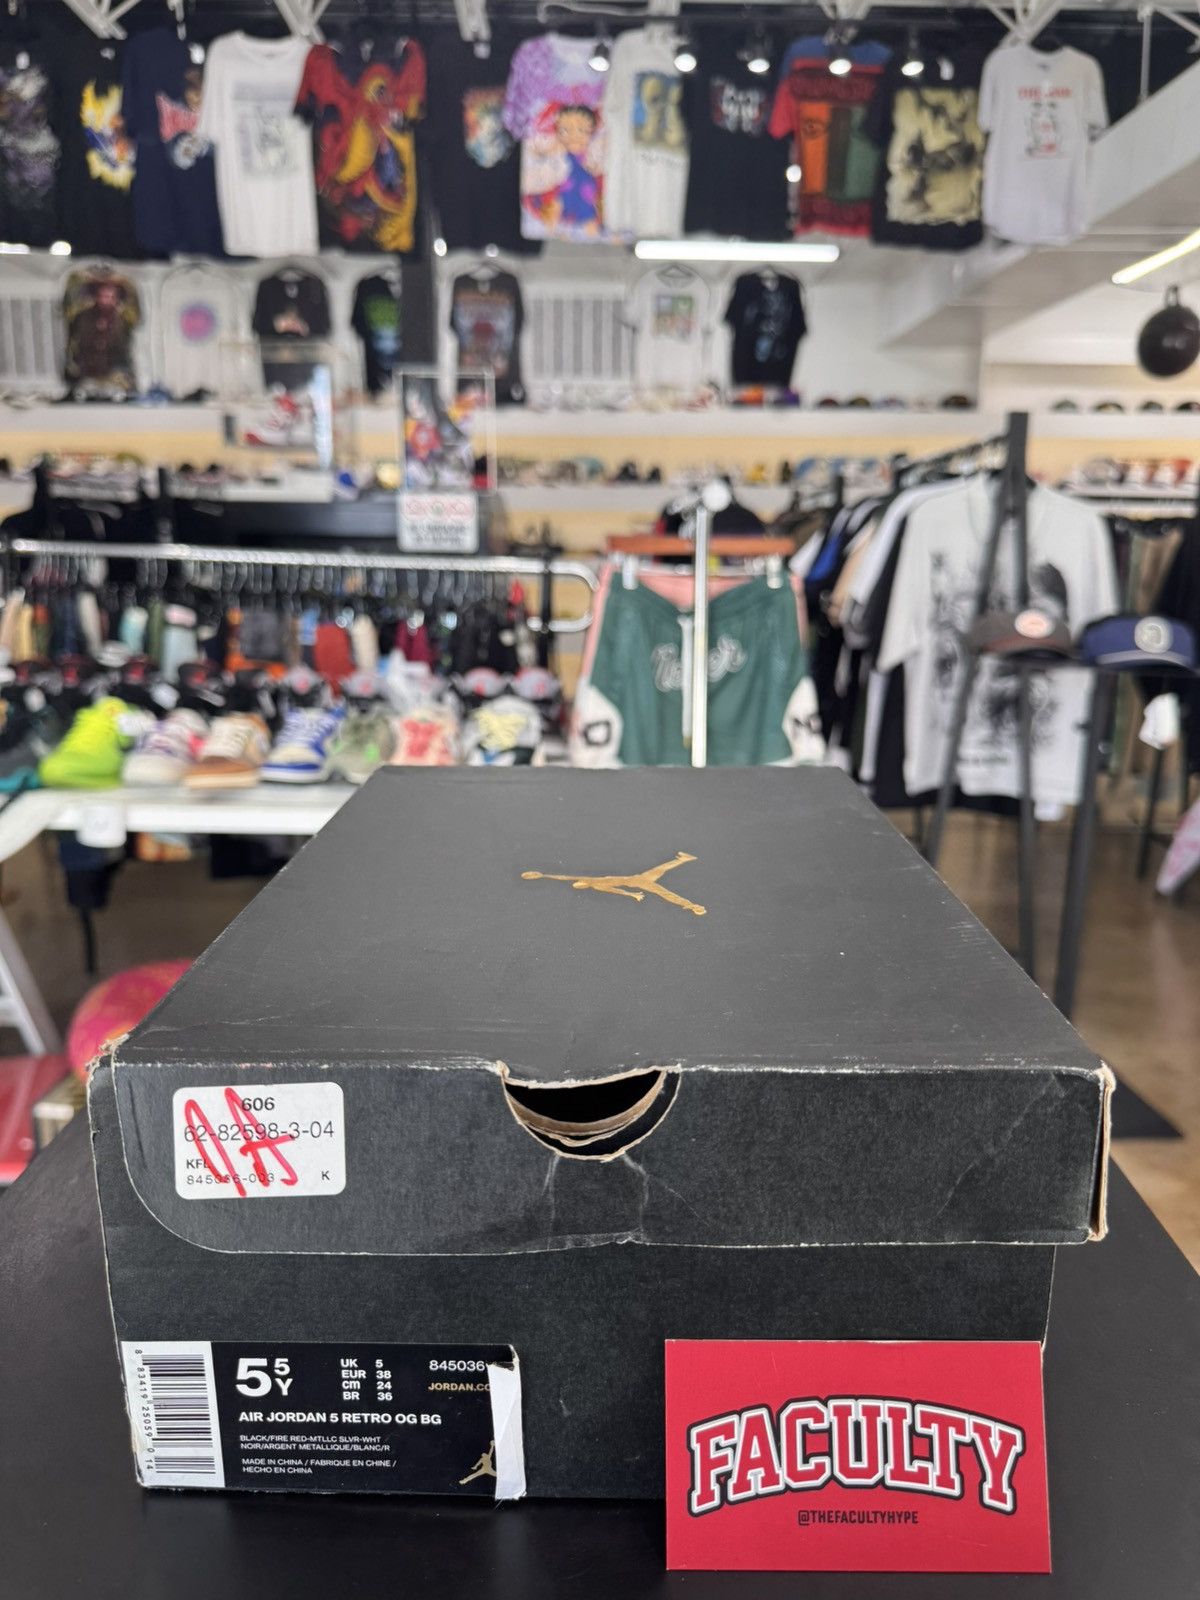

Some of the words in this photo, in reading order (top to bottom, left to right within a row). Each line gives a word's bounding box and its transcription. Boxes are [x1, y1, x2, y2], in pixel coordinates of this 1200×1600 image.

[241, 1097, 275, 1111] 606
[184, 1121, 334, 1142] 62-82598-3-04
[321, 1171, 330, 1181] K
[274, 1358, 291, 1376] 5
[340, 1358, 358, 1368] UK
[375, 1359, 384, 1369] 5
[235, 1357, 272, 1397] 5
[341, 1369, 367, 1379] EUR
[376, 1370, 392, 1379] 38
[275, 1378, 293, 1396] Y
[342, 1380, 361, 1390] cm
[376, 1381, 393, 1390] 24
[342, 1391, 361, 1401] BR
[377, 1392, 393, 1401] 36
[238, 1411, 264, 1423] AIR
[266, 1411, 327, 1423] JORDAN
[329, 1413, 340, 1423] 5
[341, 1413, 393, 1424] RETRO
[394, 1414, 418, 1424] OG
[420, 1414, 442, 1425] BG
[239, 1434, 289, 1443] BLACK/FIRE
[289, 1435, 338, 1443] RED-MTLLC
[338, 1436, 382, 1444] SLVR-WHT
[240, 1442, 297, 1451] NOIR/ARGENT
[298, 1443, 391, 1452] METALLIQUE/BLANC/R
[687, 1395, 1024, 1518] FACULTY
[241, 1458, 266, 1466] MADE
[277, 1459, 303, 1467] CHINA
[309, 1459, 351, 1468] FABRIQUE
[352, 1460, 364, 1468] EN
[365, 1460, 391, 1468] CHINE
[242, 1466, 273, 1474] HECHO
[286, 1467, 313, 1475] CHINA
[798, 1510, 919, 1526] @THEFACULTYHYPE
